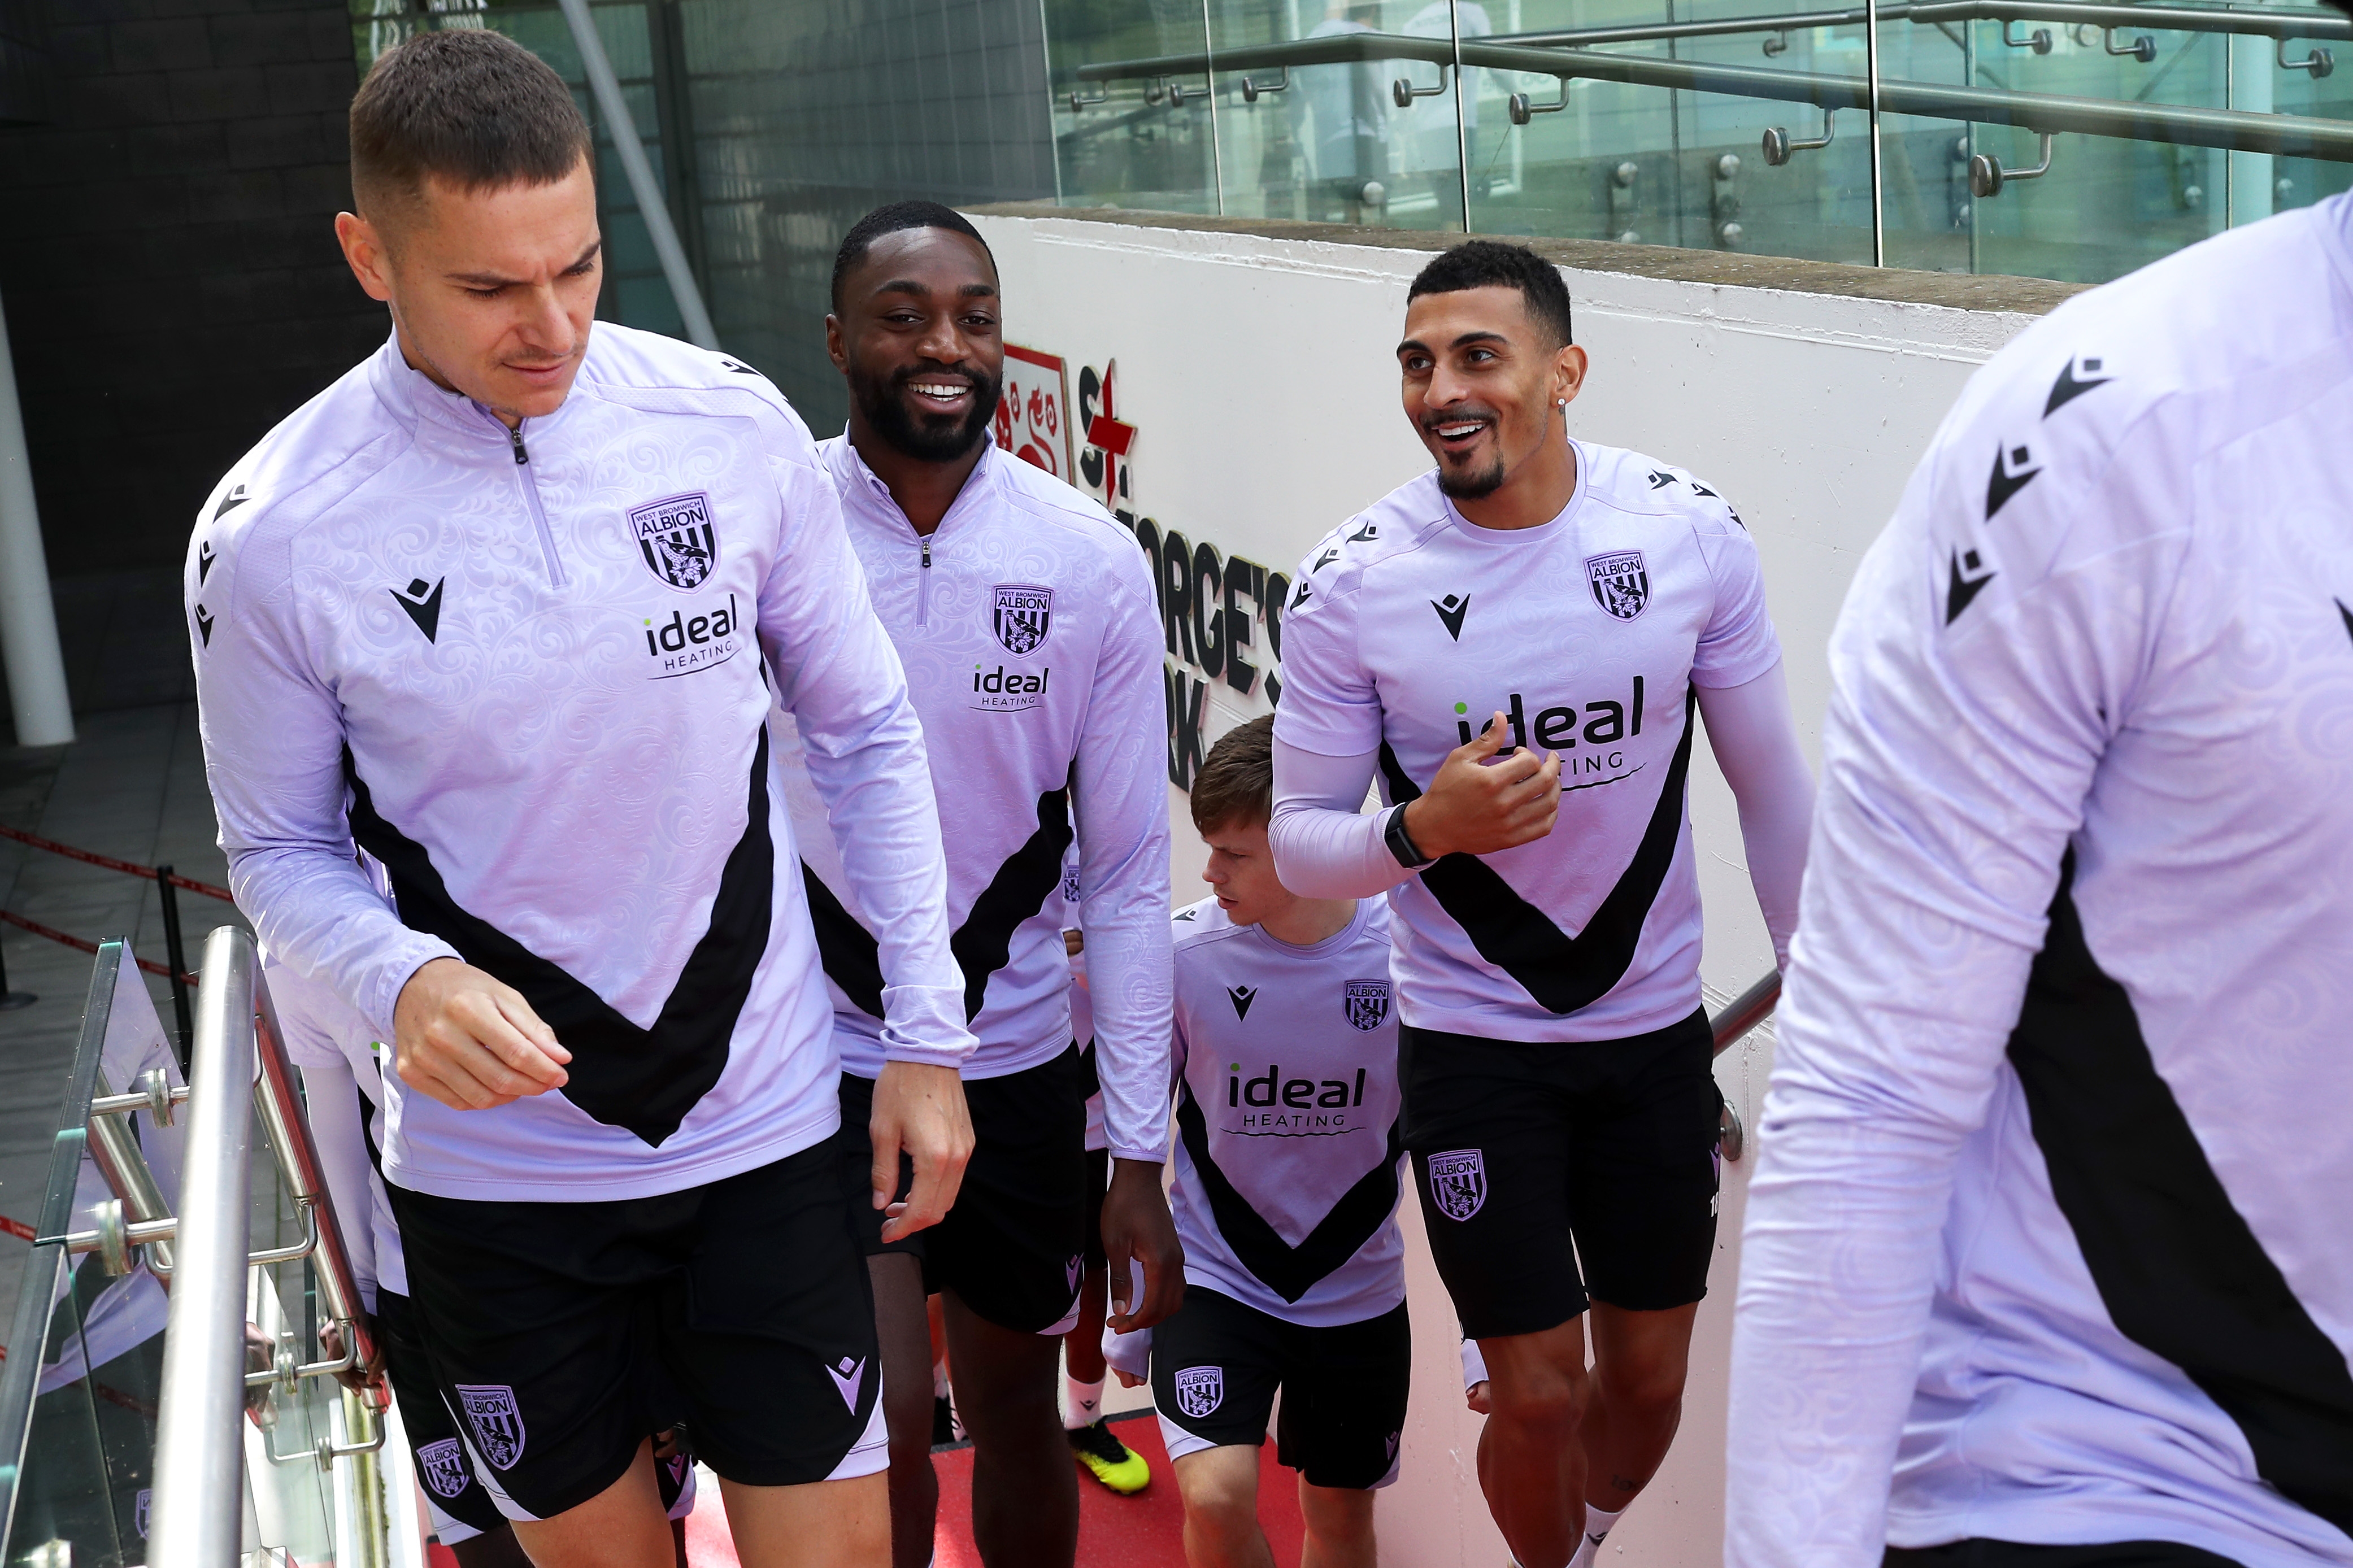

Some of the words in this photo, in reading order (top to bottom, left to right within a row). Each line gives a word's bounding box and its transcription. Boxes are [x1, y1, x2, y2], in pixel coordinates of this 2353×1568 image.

[636, 512, 656, 521] WEST
[659, 500, 701, 516] BROMWICH
[641, 507, 704, 537] ALBION
[1608, 554, 1638, 565] BROMWICH
[1593, 560, 1641, 579] ALBION
[998, 596, 1047, 609] ALBION
[643, 594, 737, 656] ideal
[665, 641, 732, 670] HEATING
[974, 664, 1049, 694] ideal
[982, 696, 1036, 706] HEATING
[1454, 675, 1644, 756] ideal
[1348, 988, 1386, 998] ALBION
[1229, 1062, 1366, 1110] ideal
[1243, 1114, 1345, 1127] HEATING
[1446, 1155, 1475, 1164] BROMWICH
[1434, 1160, 1477, 1177] ALBION
[1181, 1374, 1217, 1387] ALBION
[465, 1399, 508, 1413] ALBION
[426, 1447, 459, 1464] ALBION
